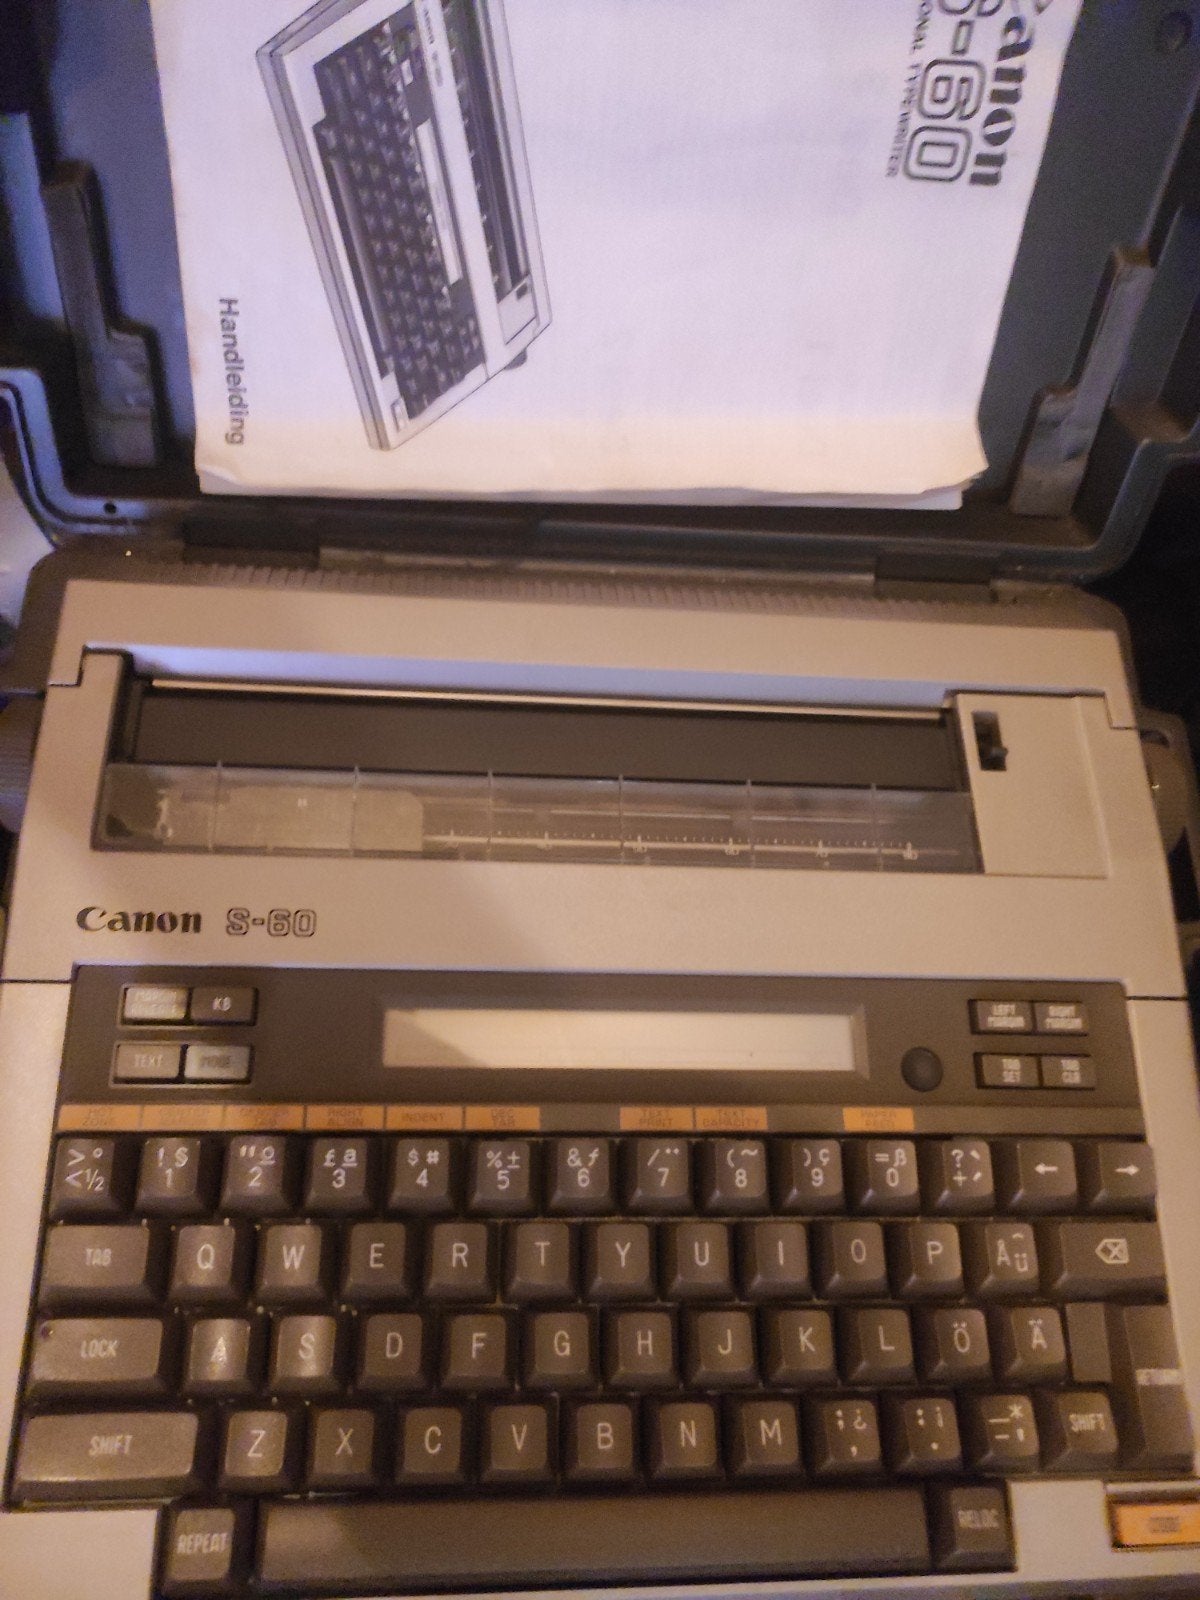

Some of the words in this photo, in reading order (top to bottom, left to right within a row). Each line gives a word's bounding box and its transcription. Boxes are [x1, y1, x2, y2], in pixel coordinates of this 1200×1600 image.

[969, 0, 1050, 186] anon
[219, 298, 249, 445] Handleiding
[76, 906, 202, 934] Canon
[226, 907, 317, 937] S-60
[165, 1168, 174, 1188] 1
[248, 1167, 263, 1188] 2
[332, 1168, 346, 1188] 3
[416, 1168, 429, 1188] 4
[497, 1170, 510, 1190] 5
[577, 1168, 591, 1188] 6
[658, 1168, 670, 1187] 7
[735, 1168, 748, 1188] 8
[811, 1168, 824, 1188] 9
[86, 1248, 112, 1267] TAB
[197, 1243, 215, 1270] Q
[282, 1244, 305, 1270] W
[369, 1243, 385, 1268] E
[452, 1242, 469, 1268] R
[535, 1241, 551, 1266] T
[615, 1241, 632, 1268] Y
[694, 1241, 710, 1266] U
[926, 1240, 943, 1264] P
[80, 1339, 119, 1358] LOCK
[298, 1332, 315, 1360] S
[385, 1332, 403, 1359] D
[471, 1332, 487, 1359] F
[554, 1330, 571, 1357] G
[637, 1329, 653, 1356] H
[718, 1328, 733, 1355] J
[799, 1326, 816, 1352] K
[879, 1325, 895, 1351] L
[597, 1422, 614, 1449] B
[680, 1420, 696, 1448] N
[759, 1418, 782, 1446] M
[1069, 1412, 1106, 1433] SHIFT
[89, 1434, 133, 1456] SHIFT
[247, 1429, 266, 1458] Z
[335, 1427, 354, 1456] X
[424, 1425, 442, 1454] C
[512, 1424, 527, 1451] V
[177, 1532, 229, 1555] REPEAT
